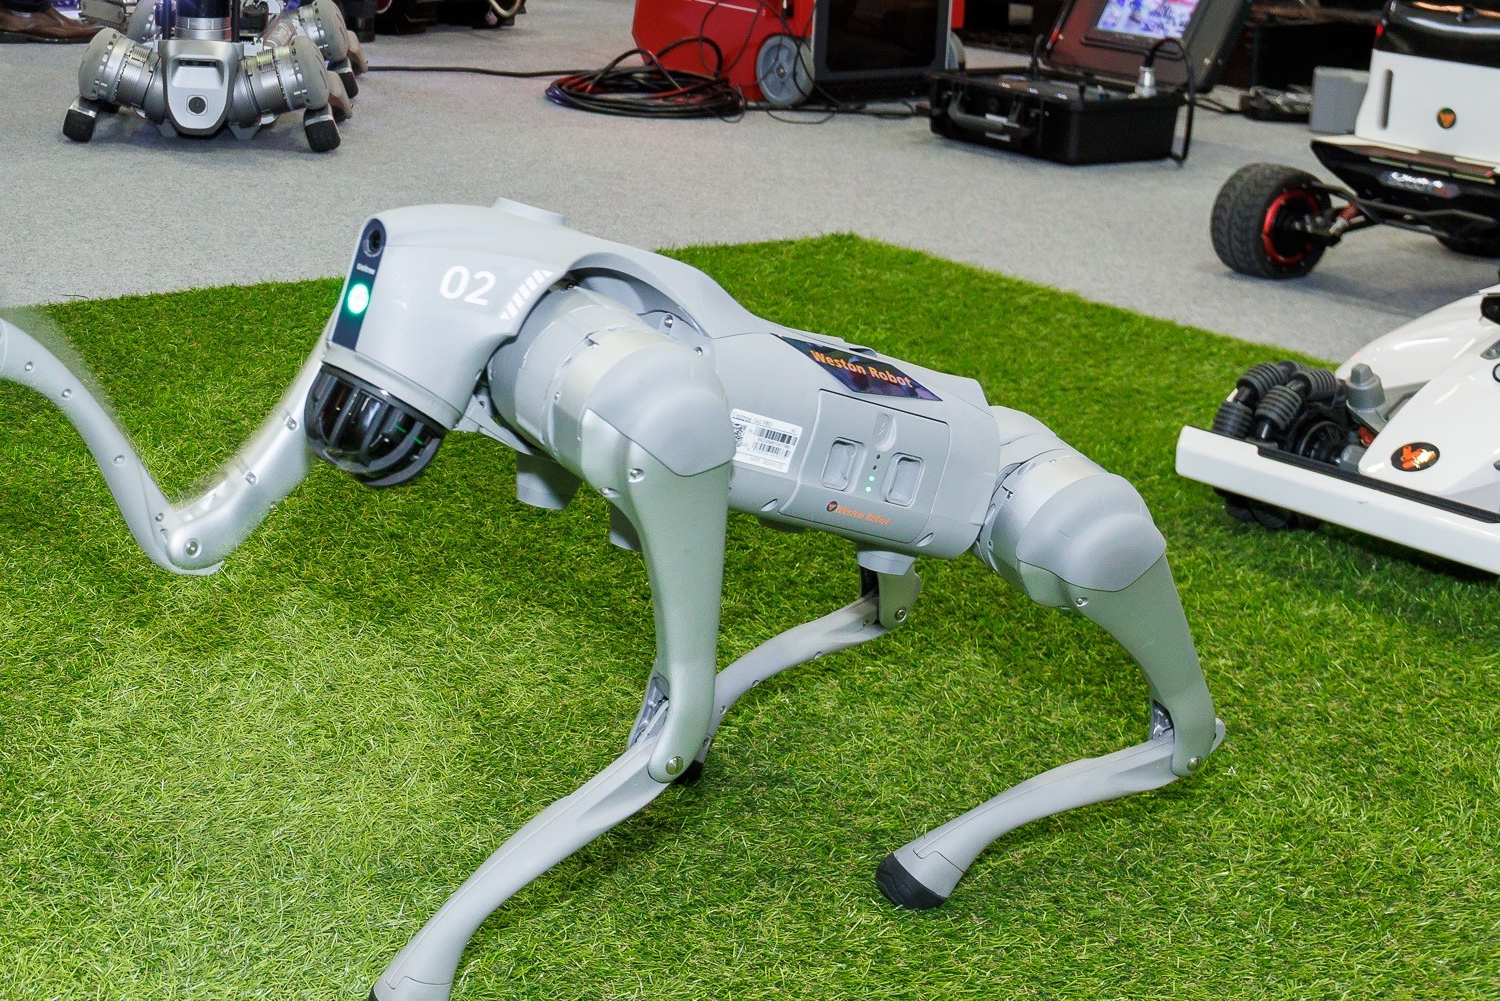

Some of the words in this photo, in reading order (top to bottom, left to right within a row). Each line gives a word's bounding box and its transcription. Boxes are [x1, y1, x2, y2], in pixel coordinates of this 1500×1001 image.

[439, 265, 496, 307] 02
[809, 350, 866, 375] Weston
[868, 366, 913, 388] Robot
